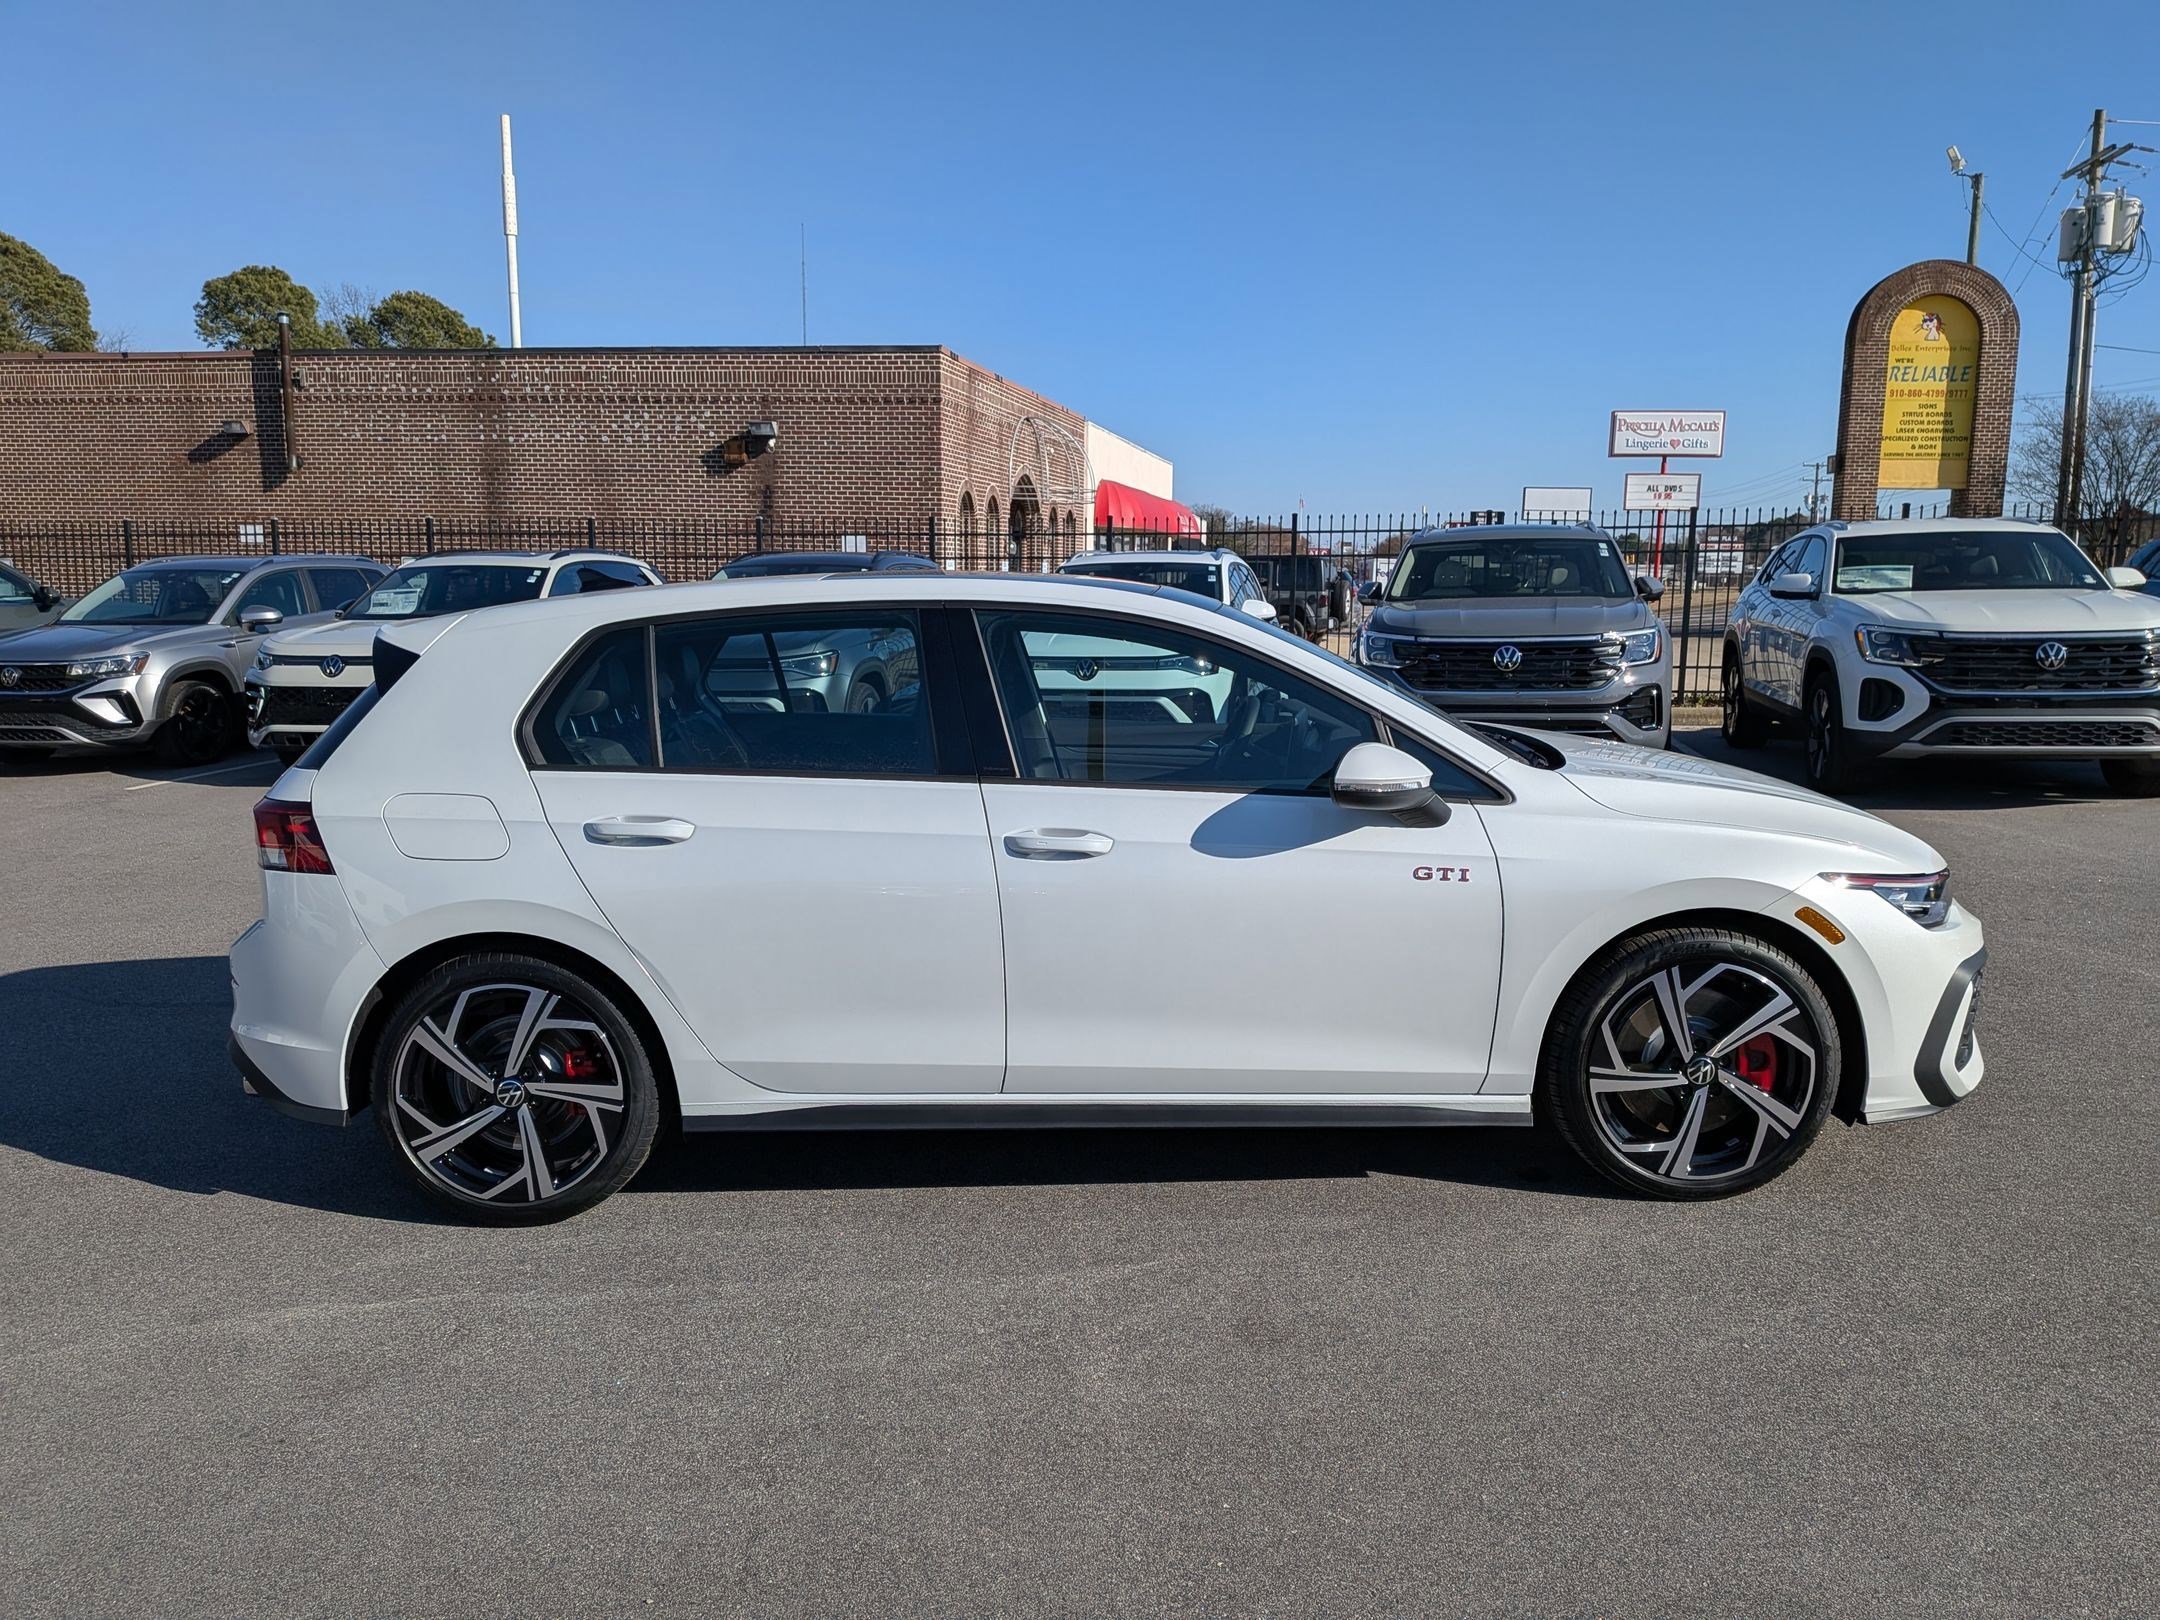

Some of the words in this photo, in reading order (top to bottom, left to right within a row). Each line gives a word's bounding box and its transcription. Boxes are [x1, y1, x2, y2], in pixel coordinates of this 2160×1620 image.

[1888, 365, 1973, 382] RELIABLE
[1617, 418, 1666, 437] PRISCILLA
[1625, 438, 1669, 451] Lingerie
[1682, 438, 1709, 448] Gifts
[1412, 866, 1470, 882] GTI
